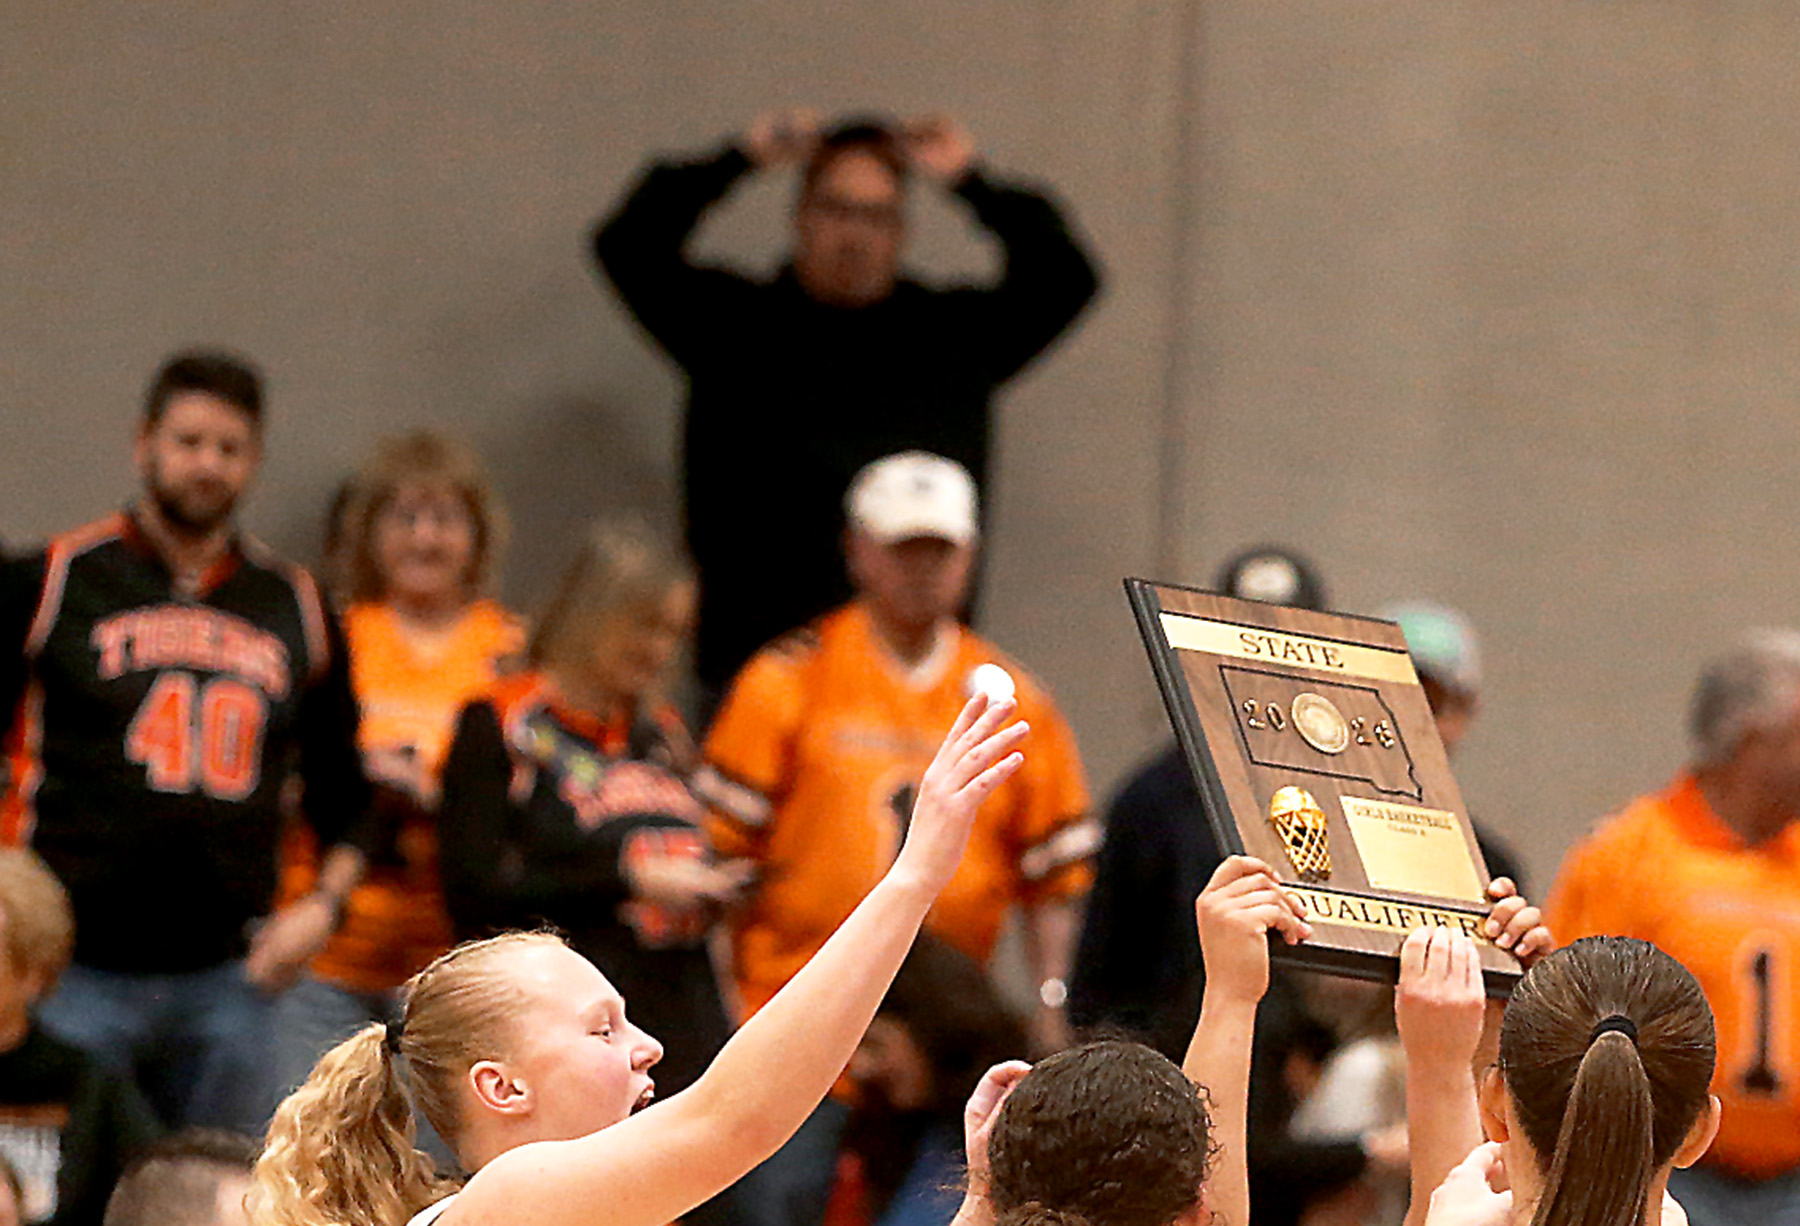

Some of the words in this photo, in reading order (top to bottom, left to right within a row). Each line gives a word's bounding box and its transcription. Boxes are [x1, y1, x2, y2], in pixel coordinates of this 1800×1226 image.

[1239, 632, 1344, 669] STATE
[1242, 698, 1287, 731] 20
[124, 669, 269, 803] 40
